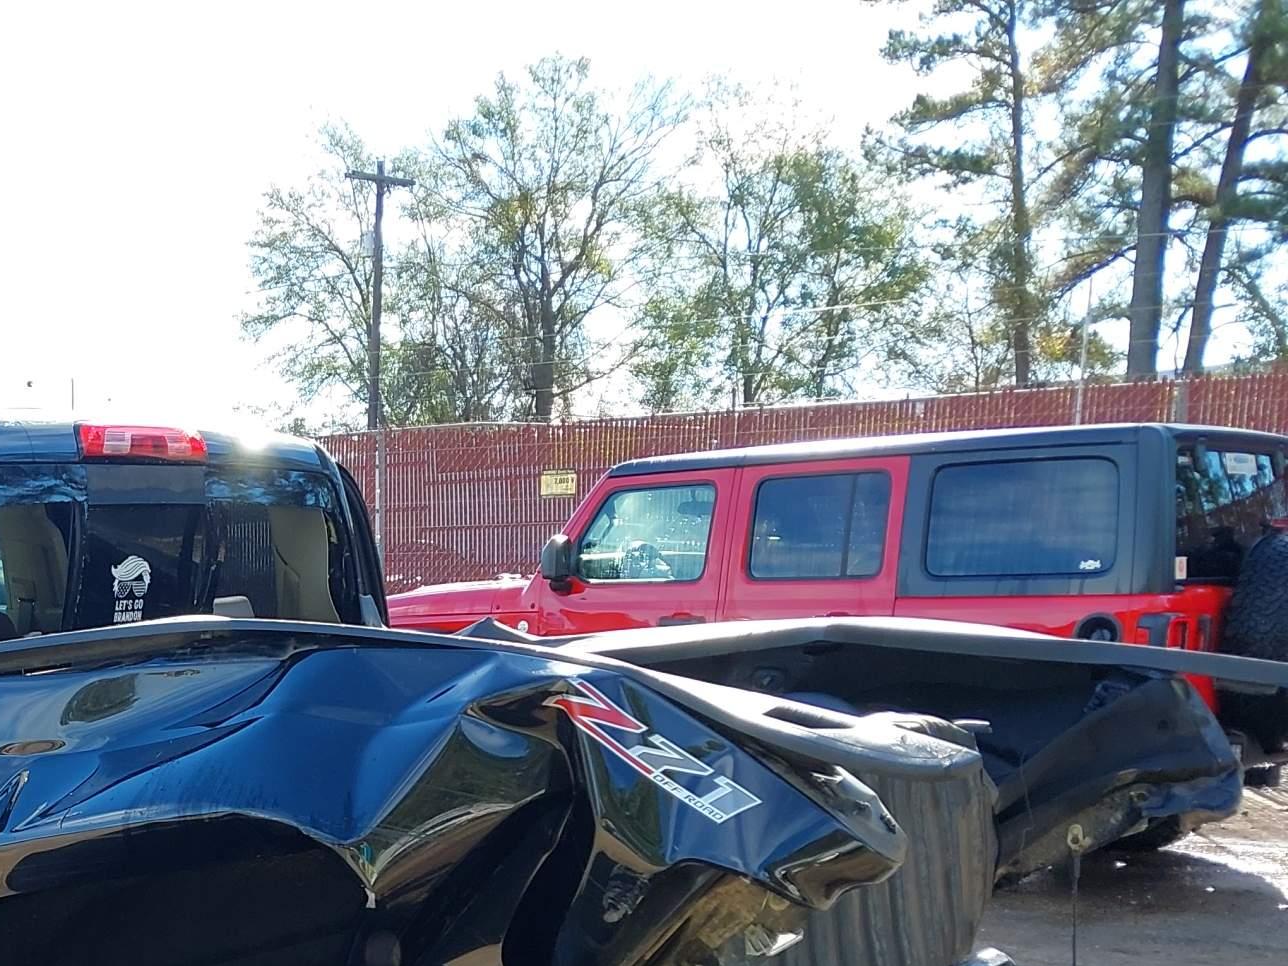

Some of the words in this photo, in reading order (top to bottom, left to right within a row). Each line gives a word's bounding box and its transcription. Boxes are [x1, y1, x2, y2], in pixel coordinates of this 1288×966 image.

[115, 599, 134, 611] LET'S
[133, 599, 144, 610] GO
[113, 610, 143, 623] BRANDON
[653, 774, 683, 794] OFF
[684, 794, 724, 821] ROAD
